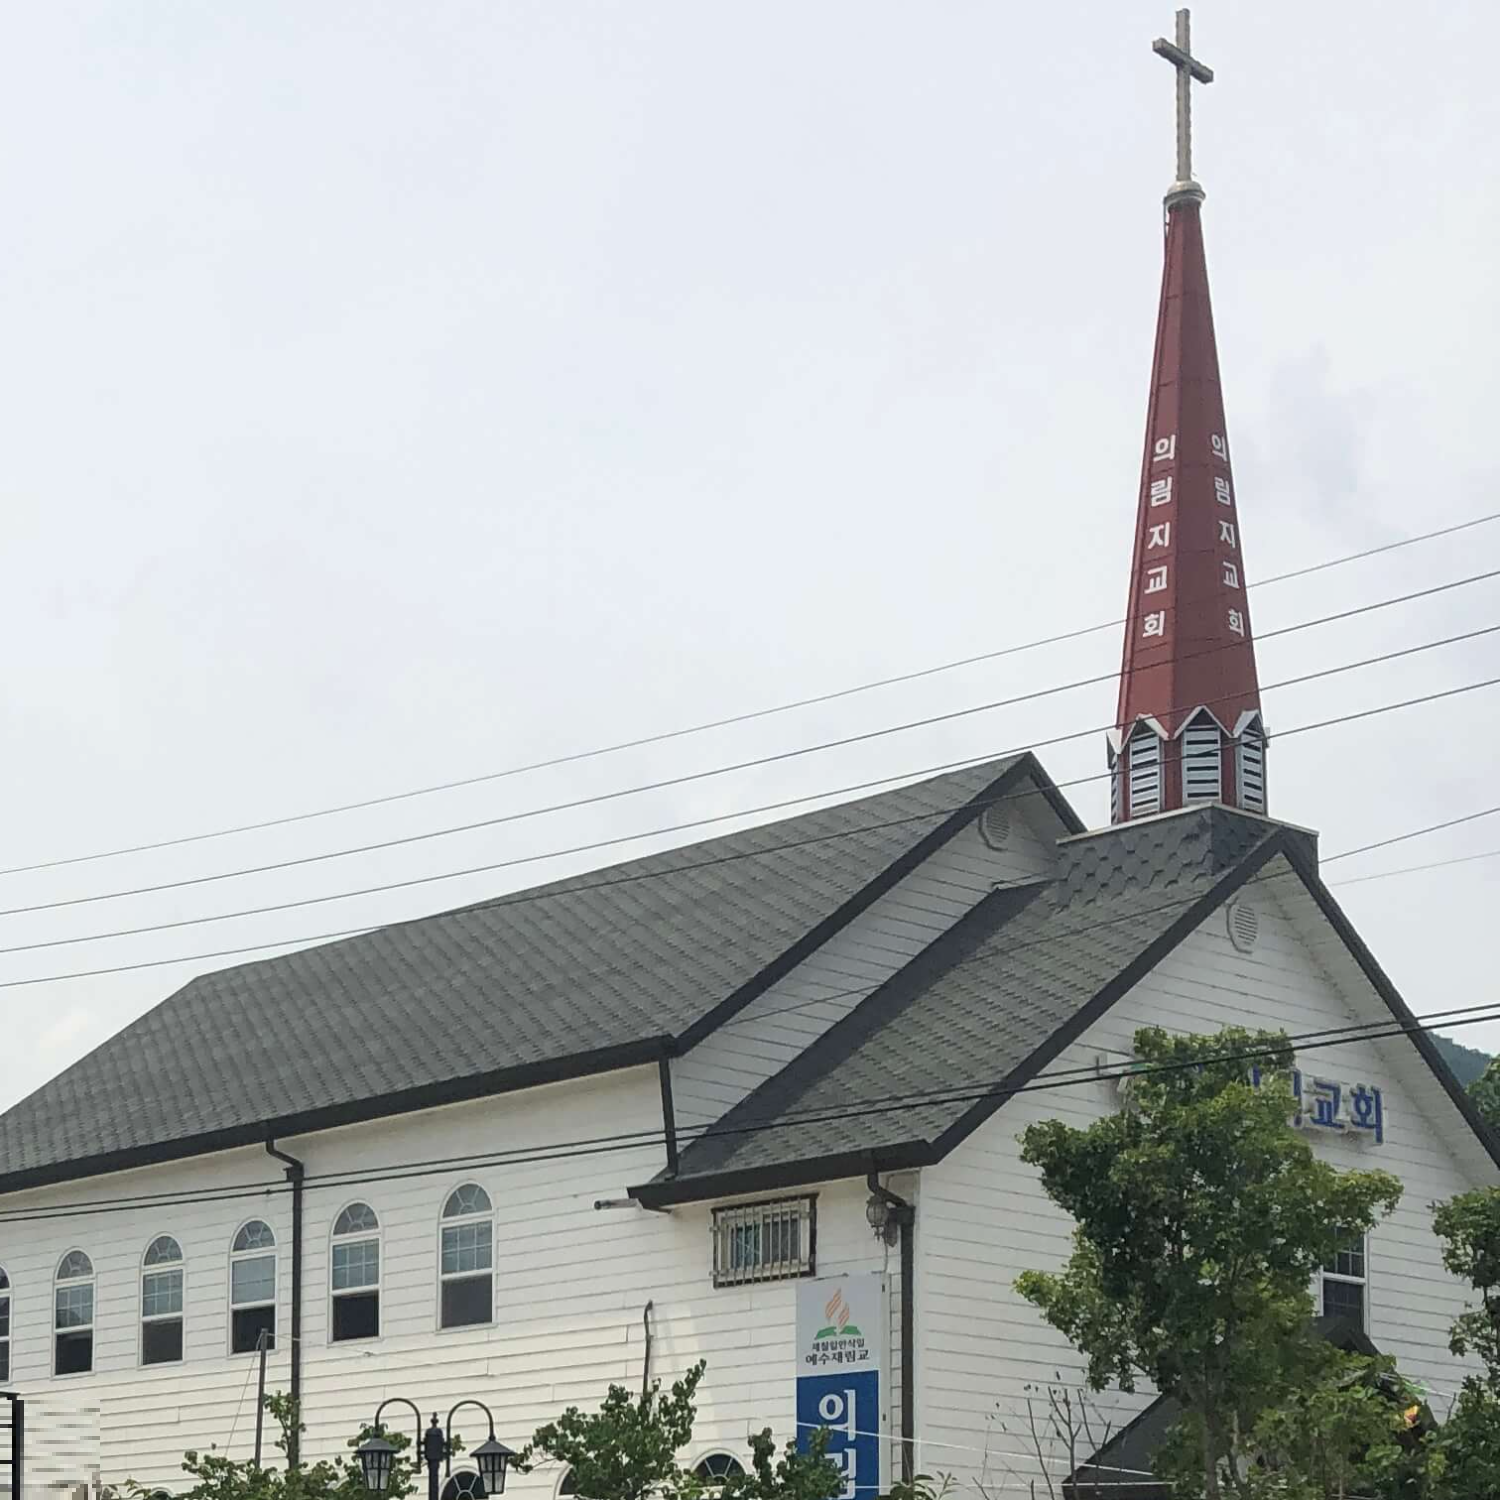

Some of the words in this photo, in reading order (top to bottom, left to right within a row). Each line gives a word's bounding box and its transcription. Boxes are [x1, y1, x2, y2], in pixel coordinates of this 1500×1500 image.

[1142, 434, 1176, 638] 의림지교회
[1211, 434, 1245, 638] 의림지교회
[805, 1349, 870, 1365] 예수재림교
